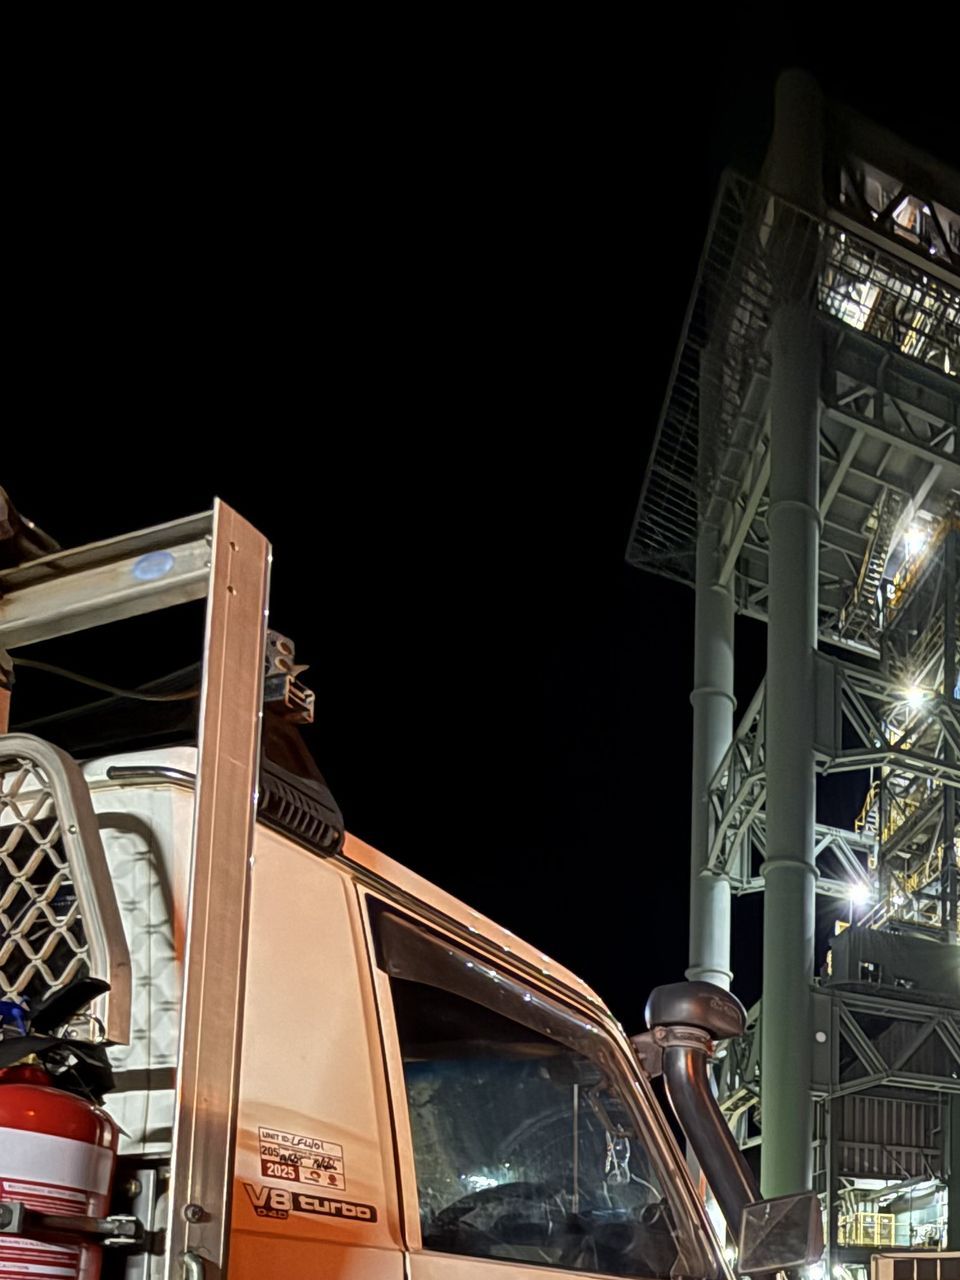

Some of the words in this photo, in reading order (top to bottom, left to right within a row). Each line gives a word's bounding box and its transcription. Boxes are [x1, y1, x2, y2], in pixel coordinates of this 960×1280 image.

[266, 1162, 296, 1179] 2025
[243, 1182, 293, 1212] V8
[298, 1194, 372, 1219] turbo
